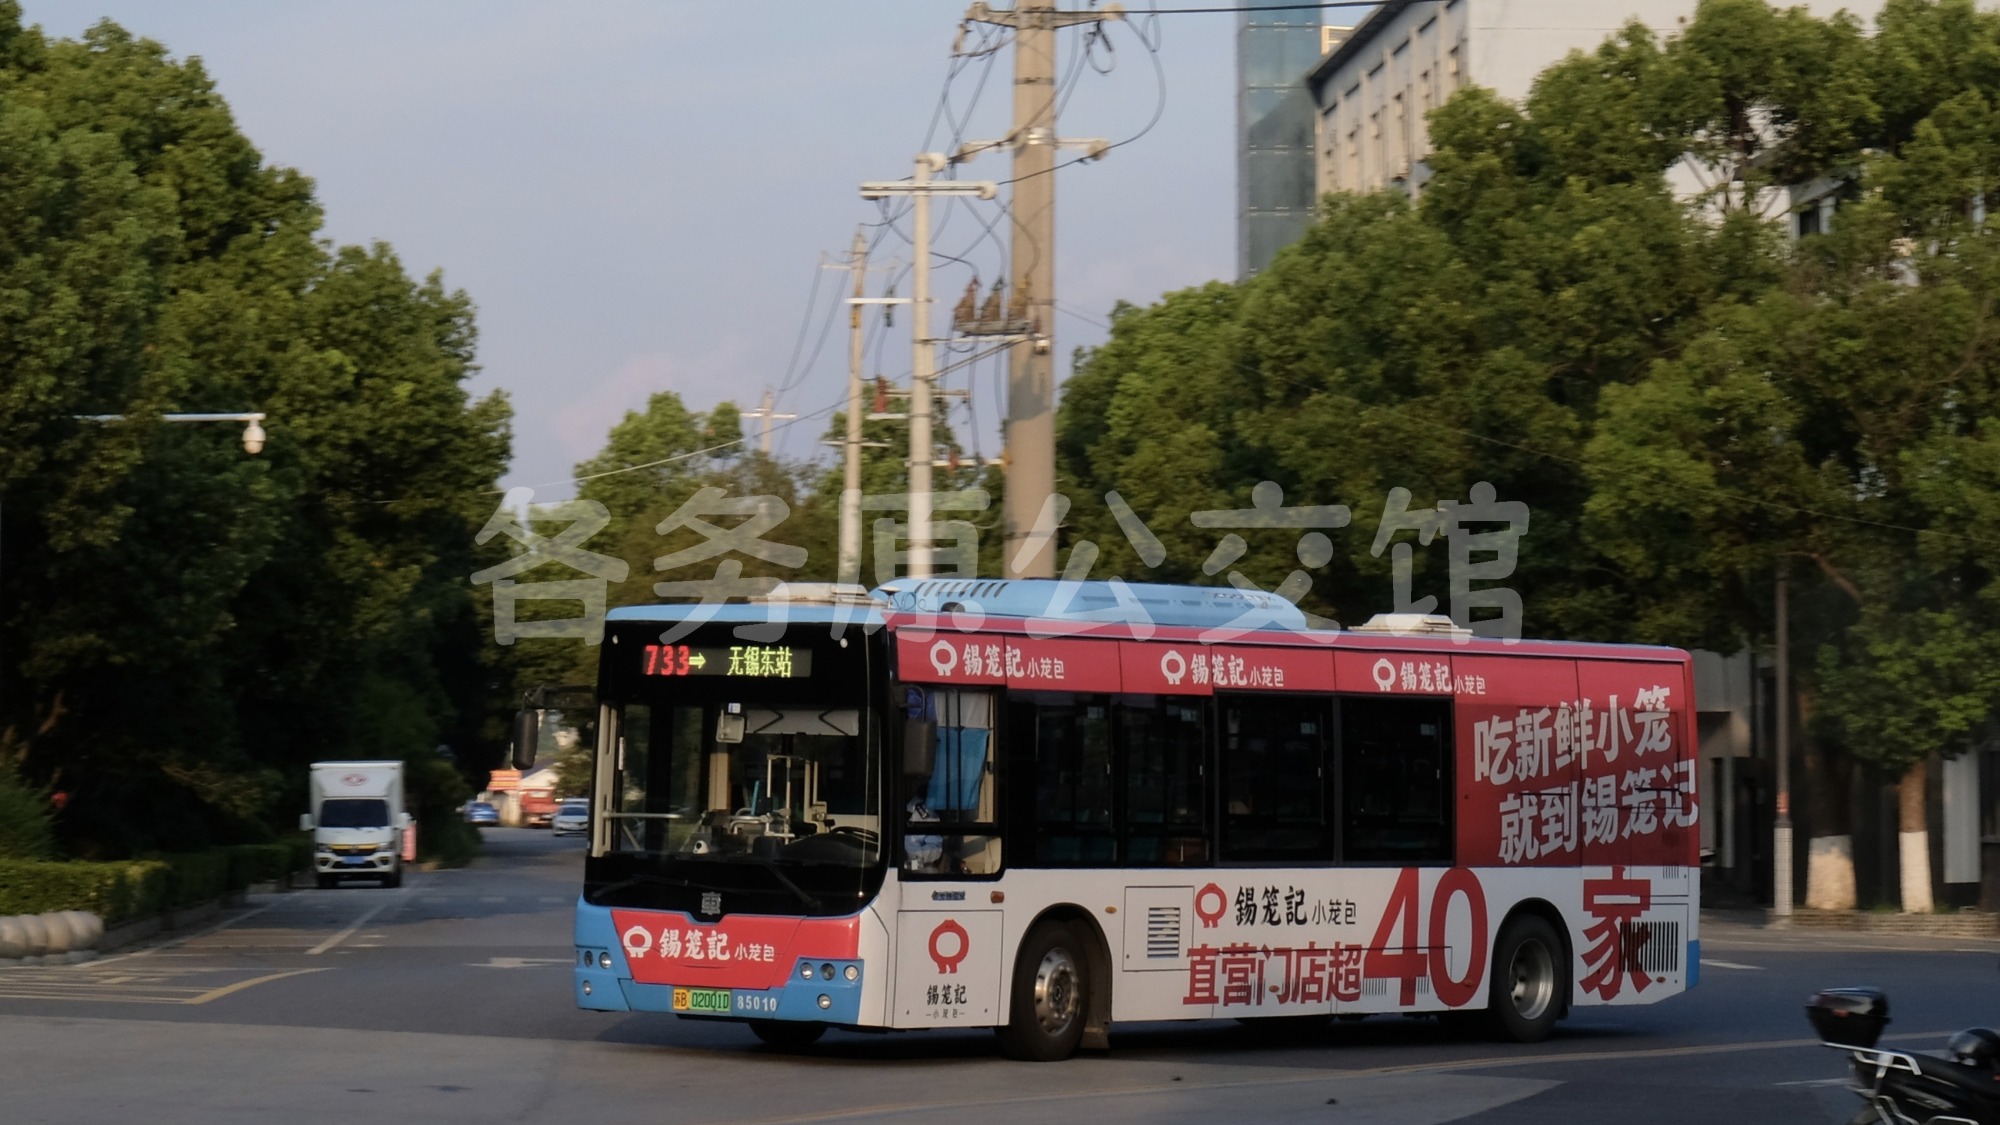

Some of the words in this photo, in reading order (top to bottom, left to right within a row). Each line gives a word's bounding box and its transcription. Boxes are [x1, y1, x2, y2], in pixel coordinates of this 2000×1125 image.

[645, 645, 690, 676] 733
[727, 645, 793, 677] 无锡东站
[1473, 685, 1672, 786] 吃新鲜小笼
[1498, 759, 1699, 864] 就到锡笼记
[1183, 941, 1362, 1006] 直营门店超
[1363, 867, 1488, 1008] 40
[1579, 865, 1653, 1001] 家
[737, 995, 777, 1011] 85010
